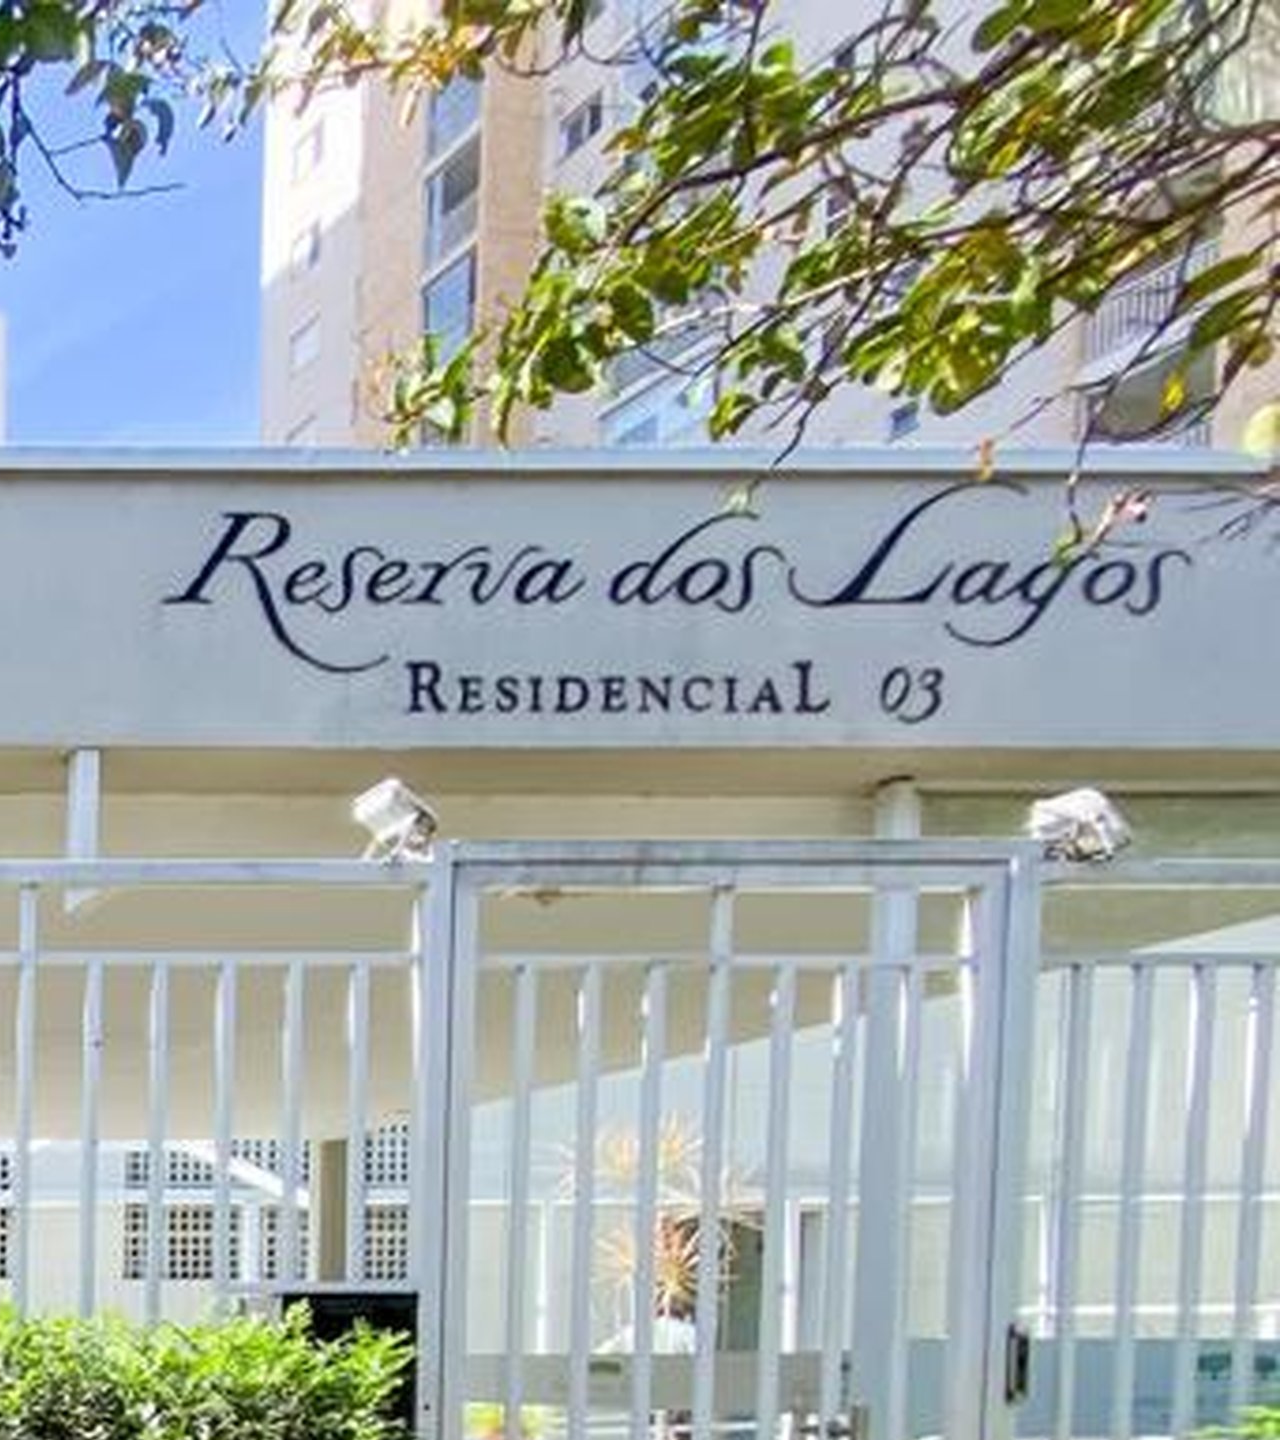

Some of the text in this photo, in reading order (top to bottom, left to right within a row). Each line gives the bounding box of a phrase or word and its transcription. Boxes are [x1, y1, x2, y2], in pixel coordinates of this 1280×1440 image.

[164, 477, 1194, 673] Reserva dos Lagos
[406, 659, 944, 724] RESIDENCIAL 03
